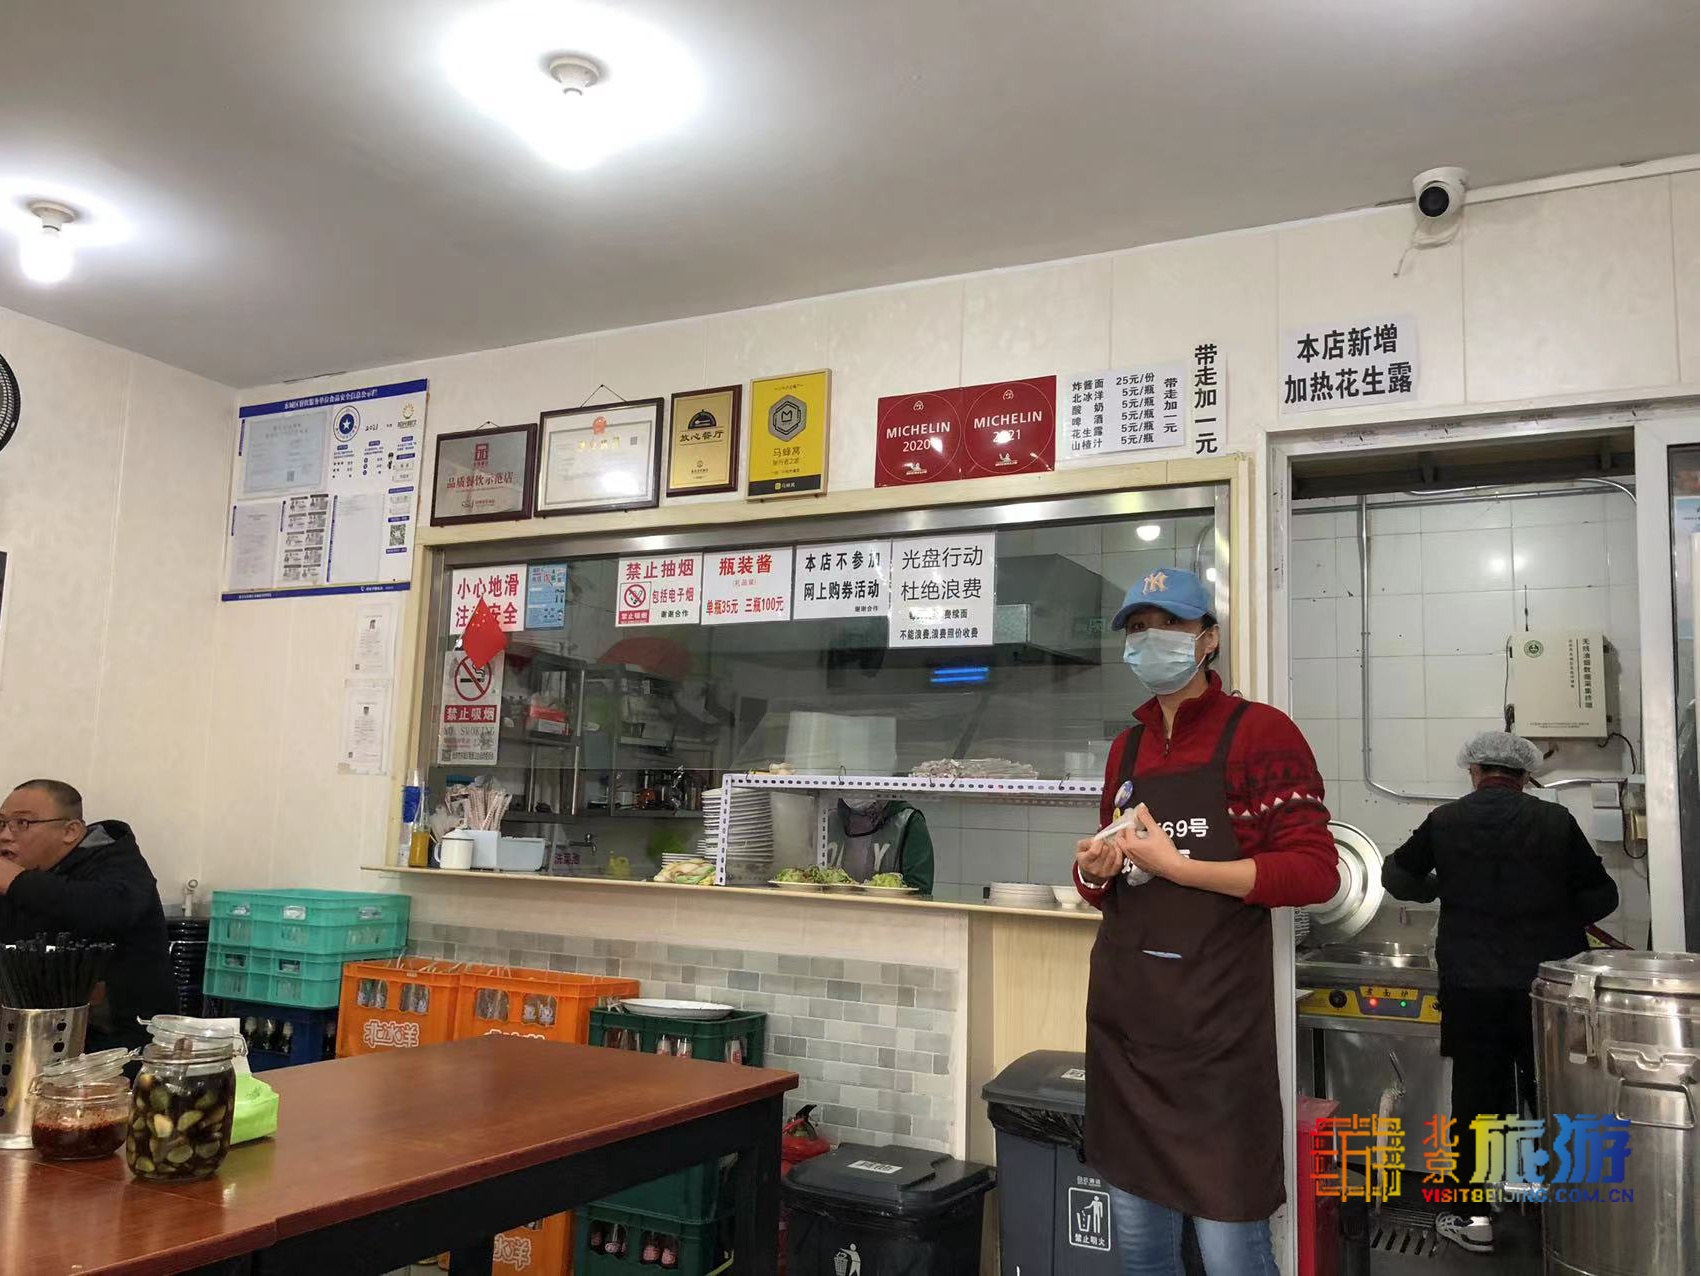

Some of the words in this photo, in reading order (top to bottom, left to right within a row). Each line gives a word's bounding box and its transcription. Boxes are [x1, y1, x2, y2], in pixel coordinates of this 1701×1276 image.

[1297, 323, 1397, 363] 本店新增
[1072, 378, 1104, 392] 炸酱面
[1116, 373, 1155, 386] 25元/份
[1285, 362, 1412, 404] 加热花生露
[1072, 390, 1104, 404] 北冰洋
[1122, 384, 1154, 396] 5元/瓶
[1194, 344, 1218, 454] 带走加一元
[1072, 402, 1104, 416] 酸奶
[1122, 396, 1154, 408] 5元/瓶
[1164, 378, 1178, 433] 带走加一元
[974, 411, 1042, 429] MICHELIN
[1072, 414, 1104, 427] 啤酒
[1122, 408, 1154, 420] 5元/瓶
[680, 431, 724, 442] 放心餐厅
[886, 422, 950, 439] MICHELIN
[992, 429, 1021, 443] 221
[1072, 426, 1103, 439] 花生露
[1121, 421, 1154, 433] 5元/瓶
[902, 438, 931, 452] 2020
[1072, 438, 1102, 450] 山楂汁
[1121, 432, 1154, 445] 5元/瓶
[774, 446, 800, 458] 马蜂窝
[446, 472, 514, 488] 品质餐饮示范店
[719, 554, 772, 576] 瓶装酱
[804, 550, 880, 572] 本店不参加
[902, 546, 983, 570] 光盘行动
[626, 558, 694, 580] 禁止抽烟
[456, 574, 520, 600] 小心地滑
[652, 587, 694, 604] 包括电子烟
[804, 579, 880, 600] 网上购券活动
[901, 578, 982, 602] 杜绝浪费
[456, 602, 518, 628] 注安全
[660, 610, 690, 619] 谢谢合作
[706, 600, 739, 616] 单瓶35元
[744, 596, 784, 613] 三瓶100元
[900, 627, 979, 640] 不能浪费,浪费照价收费
[446, 706, 496, 720] 禁止吸烟
[1157, 818, 1209, 838] 69号
[364, 1018, 419, 1048] 北冰洋
[1074, 1233, 1105, 1246] 禁止明火
